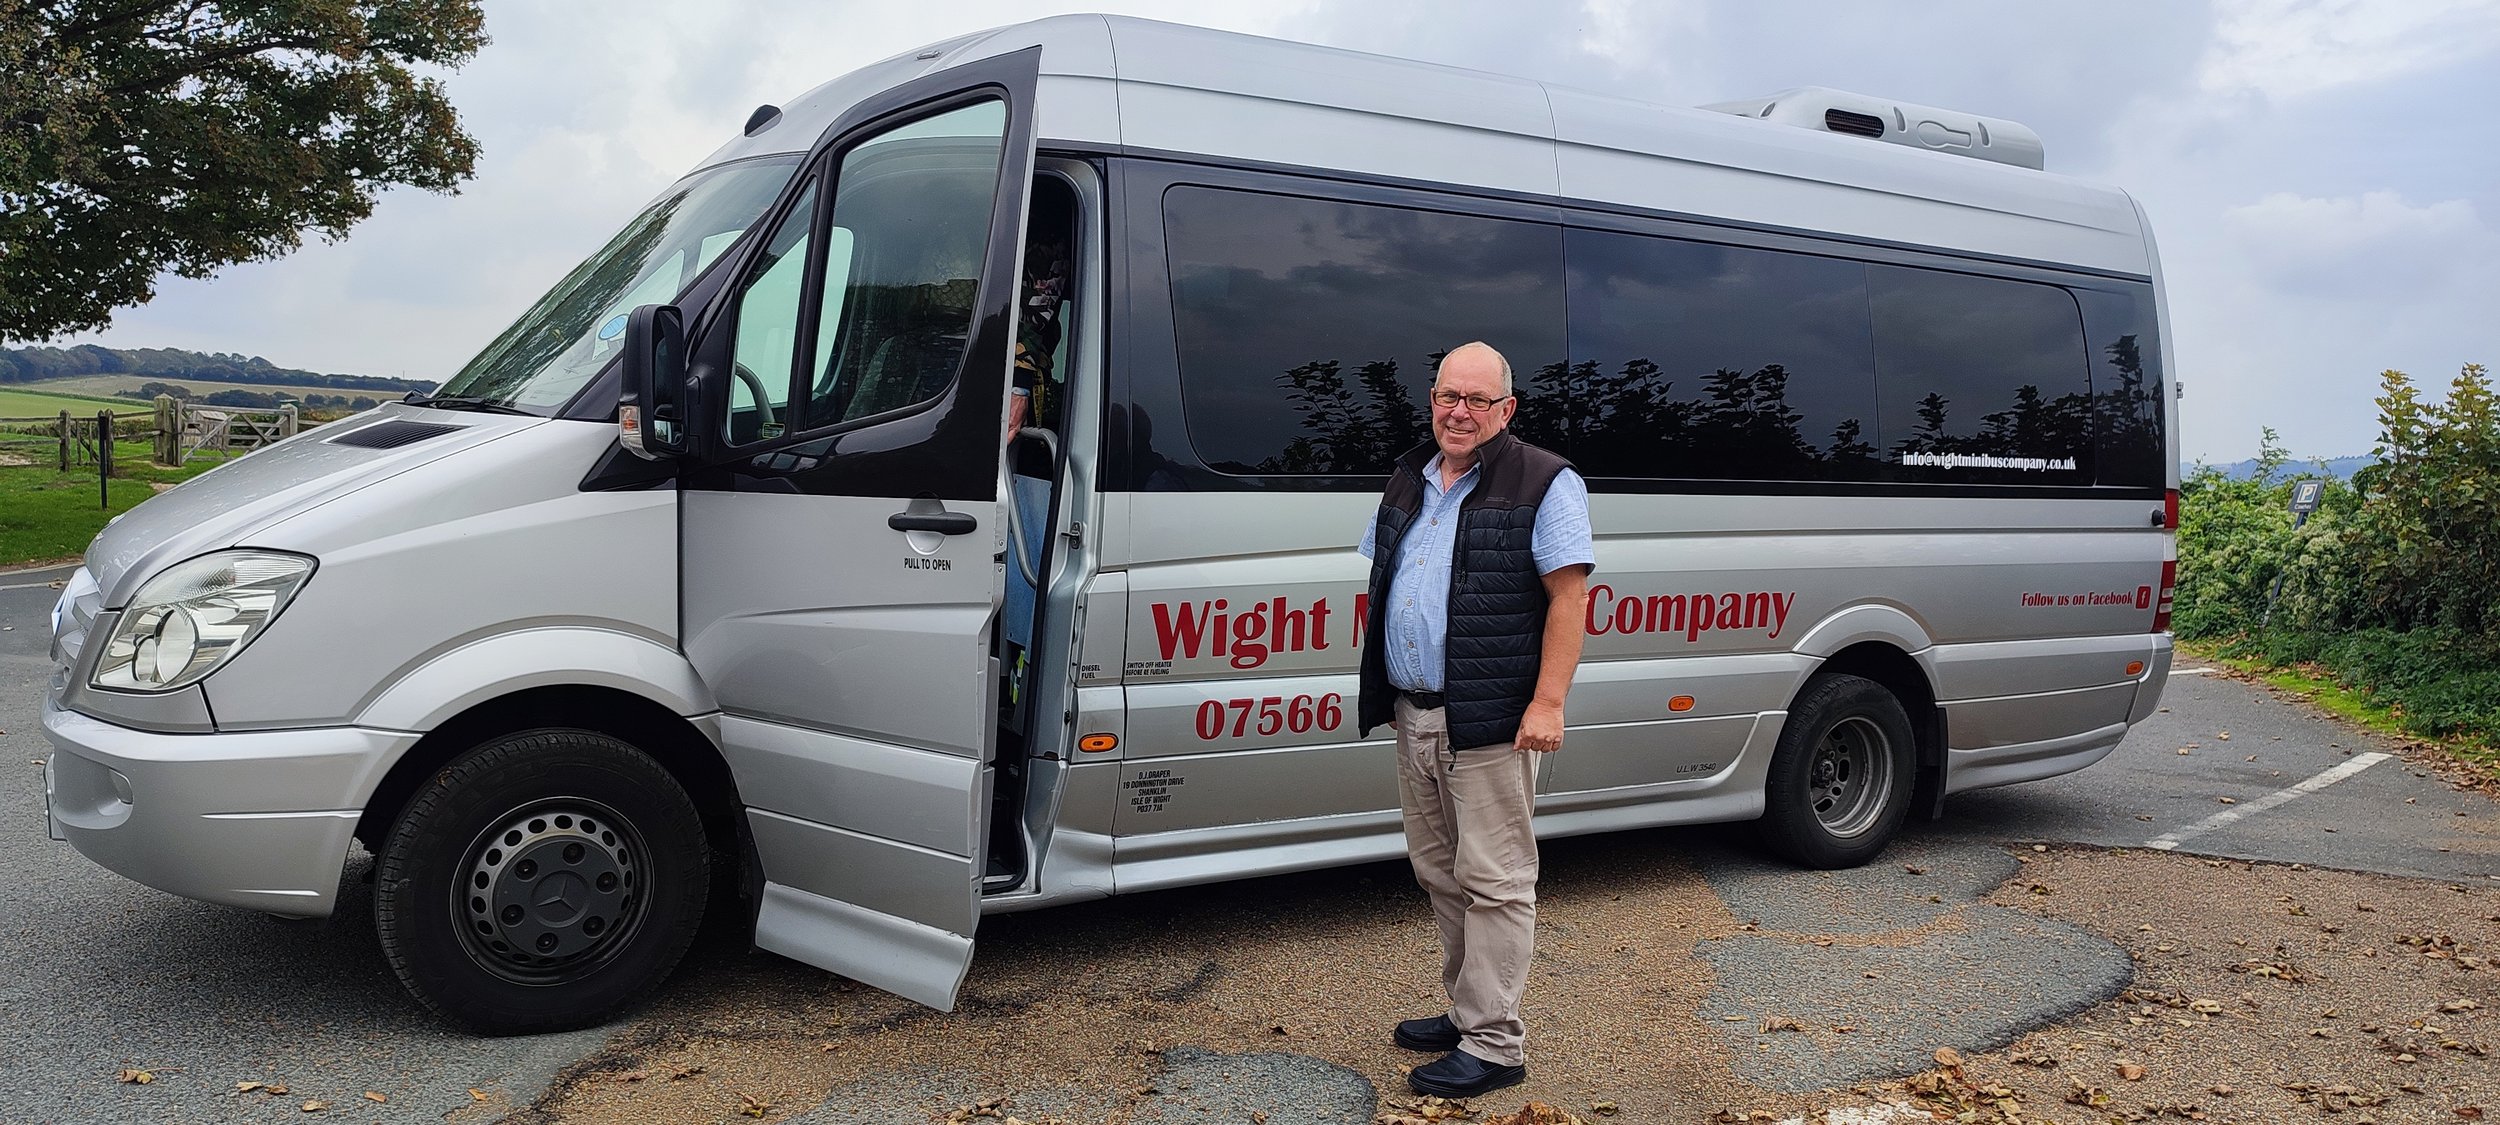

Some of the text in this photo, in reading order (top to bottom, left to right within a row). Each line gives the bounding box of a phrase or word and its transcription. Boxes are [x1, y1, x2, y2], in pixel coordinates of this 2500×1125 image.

[1902, 451, 2077, 472] info@wightminibuscompany.co.uk
[2301, 485, 2314, 501] P
[904, 558, 951, 571] PULL TO OPEN
[2021, 592, 2055, 607] Follow
[2057, 595, 2070, 606] us
[2072, 595, 2085, 606] on
[2088, 591, 2133, 606] Facebook
[1151, 596, 1332, 670] Wight
[1585, 583, 1795, 643] Company
[1081, 664, 1101, 672] DIESEL
[1145, 661, 1155, 669] OFF
[1195, 692, 1342, 740] 07566
[1168, 777, 1185, 786] DRIVE
[1138, 787, 1167, 796] SHANKLIN
[1131, 795, 1171, 805] ISLE OF WIGHT
